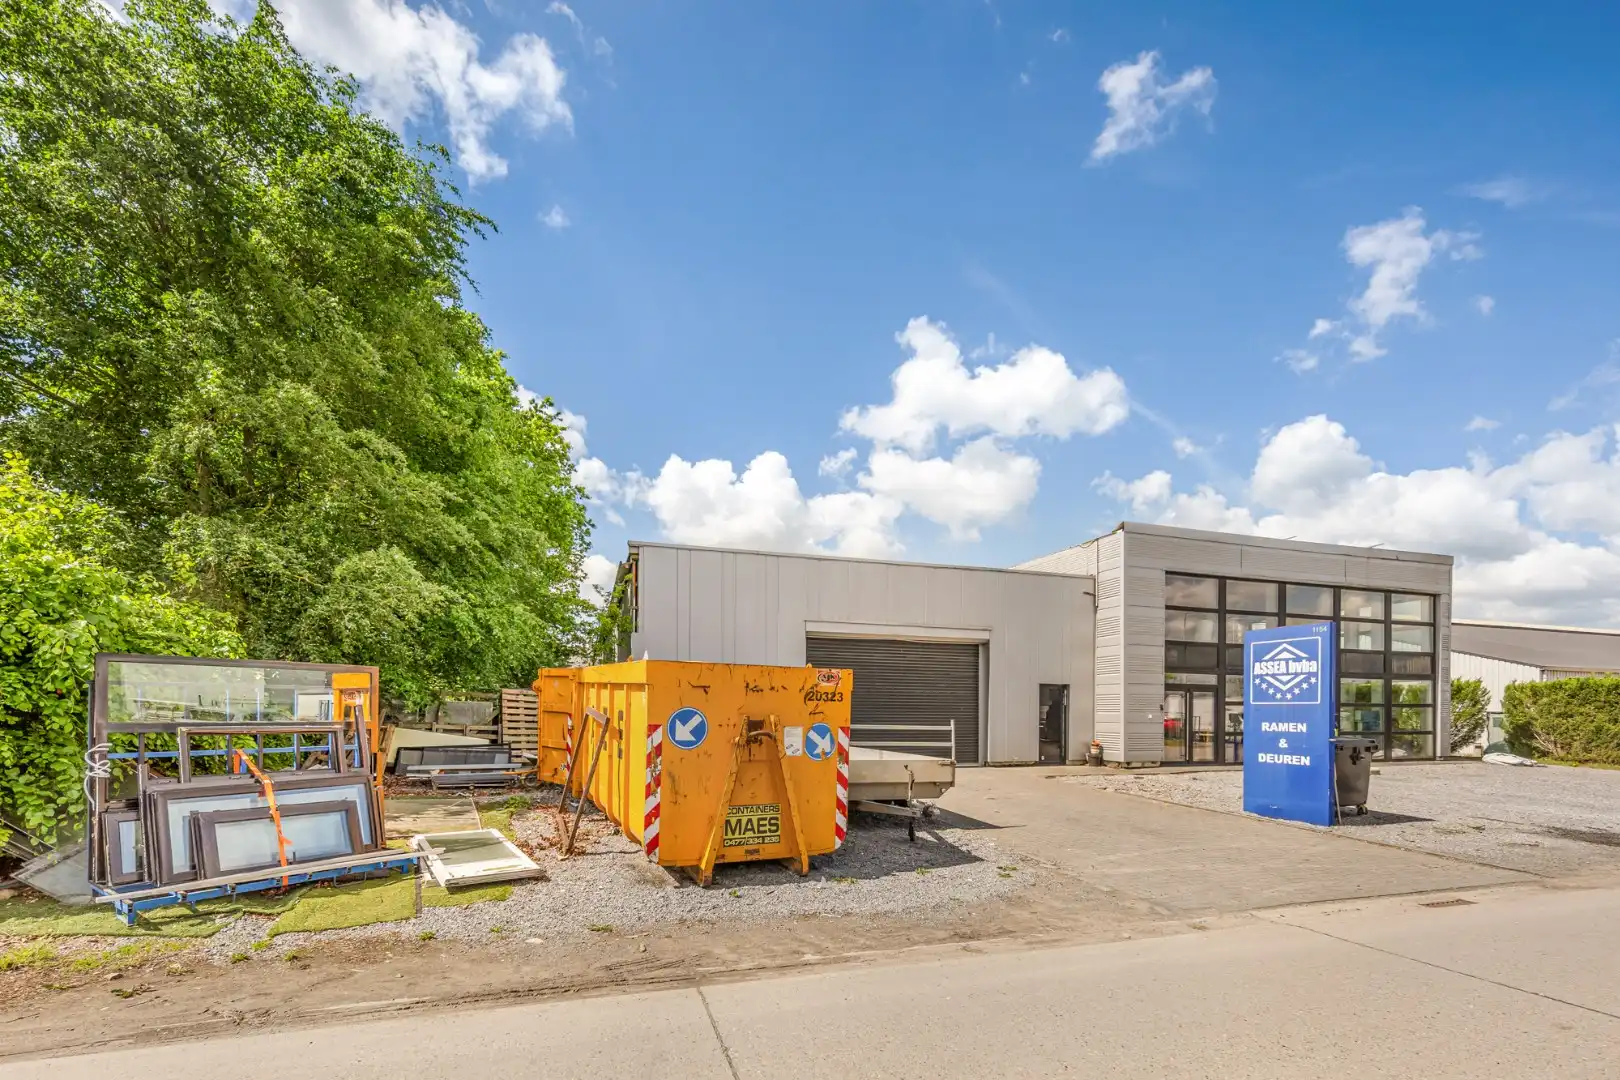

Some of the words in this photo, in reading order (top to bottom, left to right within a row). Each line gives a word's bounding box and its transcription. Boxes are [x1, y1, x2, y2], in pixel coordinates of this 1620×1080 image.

[1253, 660, 1287, 675] ASSEA
[1288, 659, 1317, 673] bvba
[807, 691, 844, 702] 20323
[1261, 722, 1307, 733] RAMEN
[1278, 738, 1288, 748] &
[1258, 753, 1311, 766] DEUREN
[725, 816, 780, 836] MAES
[724, 839, 745, 847] 0477
